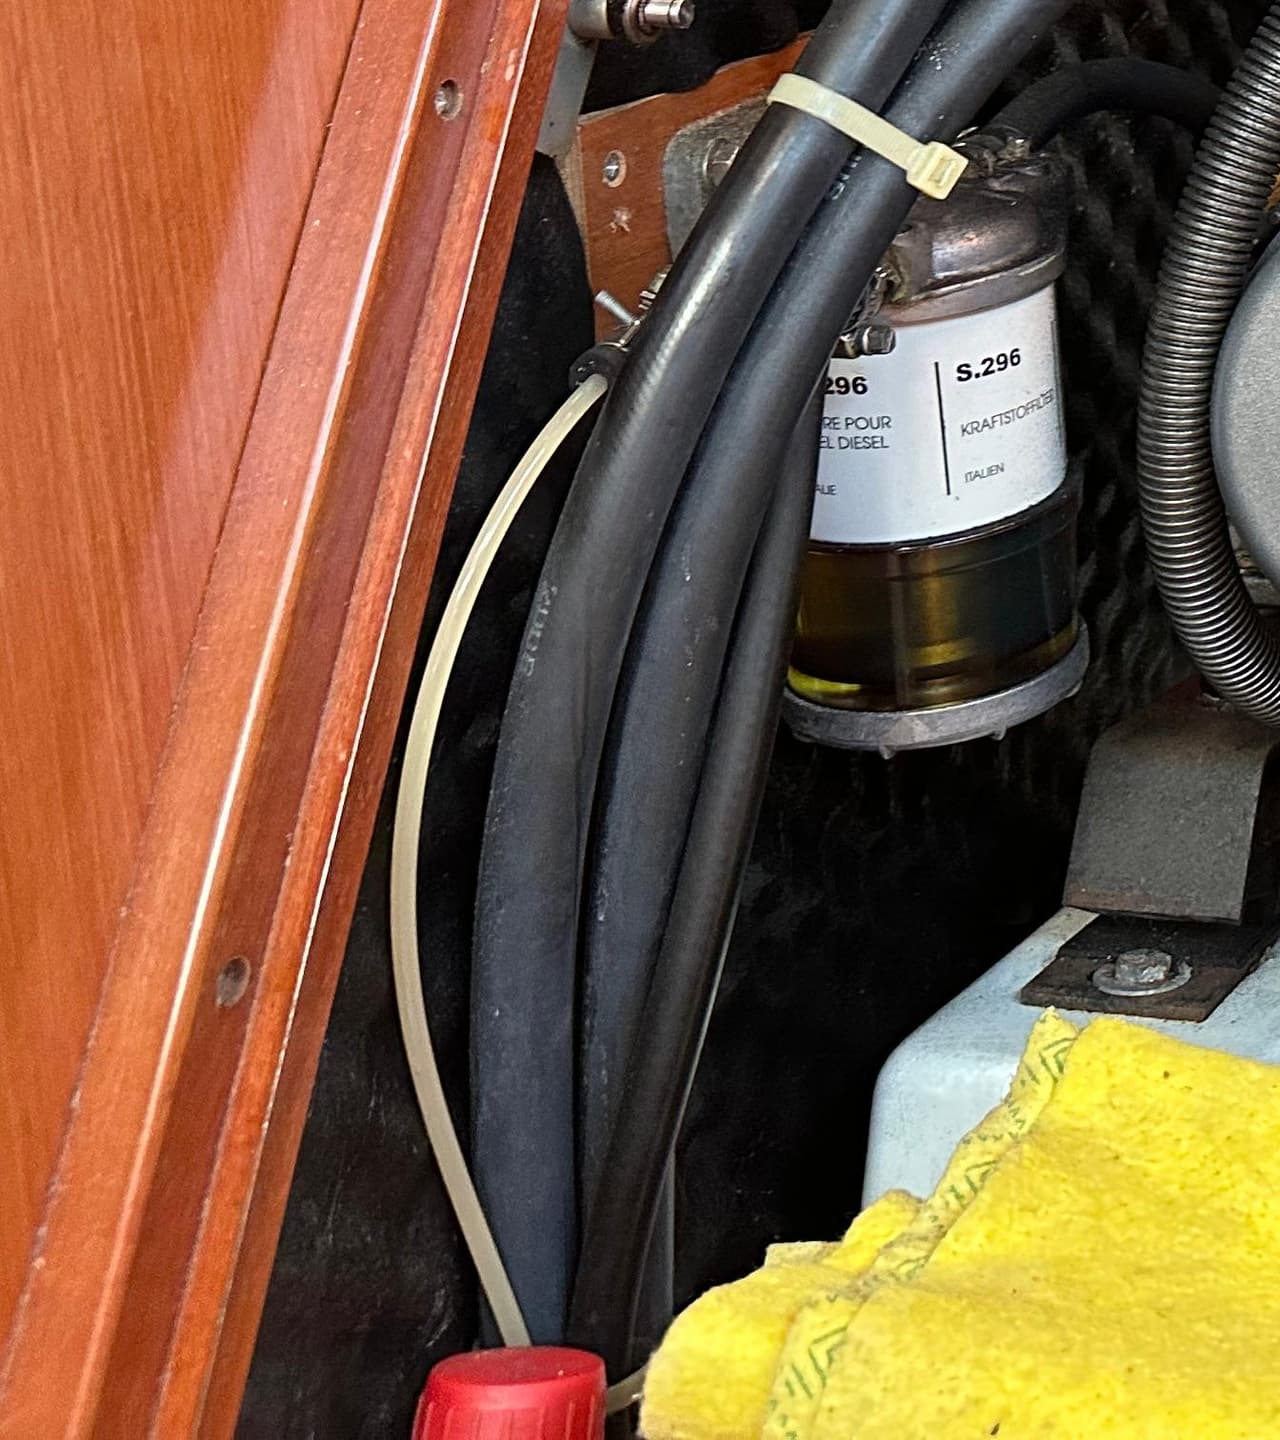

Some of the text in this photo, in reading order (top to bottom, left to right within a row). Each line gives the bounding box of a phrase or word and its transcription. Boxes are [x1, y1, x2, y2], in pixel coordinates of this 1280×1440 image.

[956, 348, 1021, 382] S.296
[823, 376, 868, 395] 296
[845, 415, 892, 430] POUR
[838, 435, 890, 450] DIESEL
[964, 462, 1005, 482] ITALIEN
